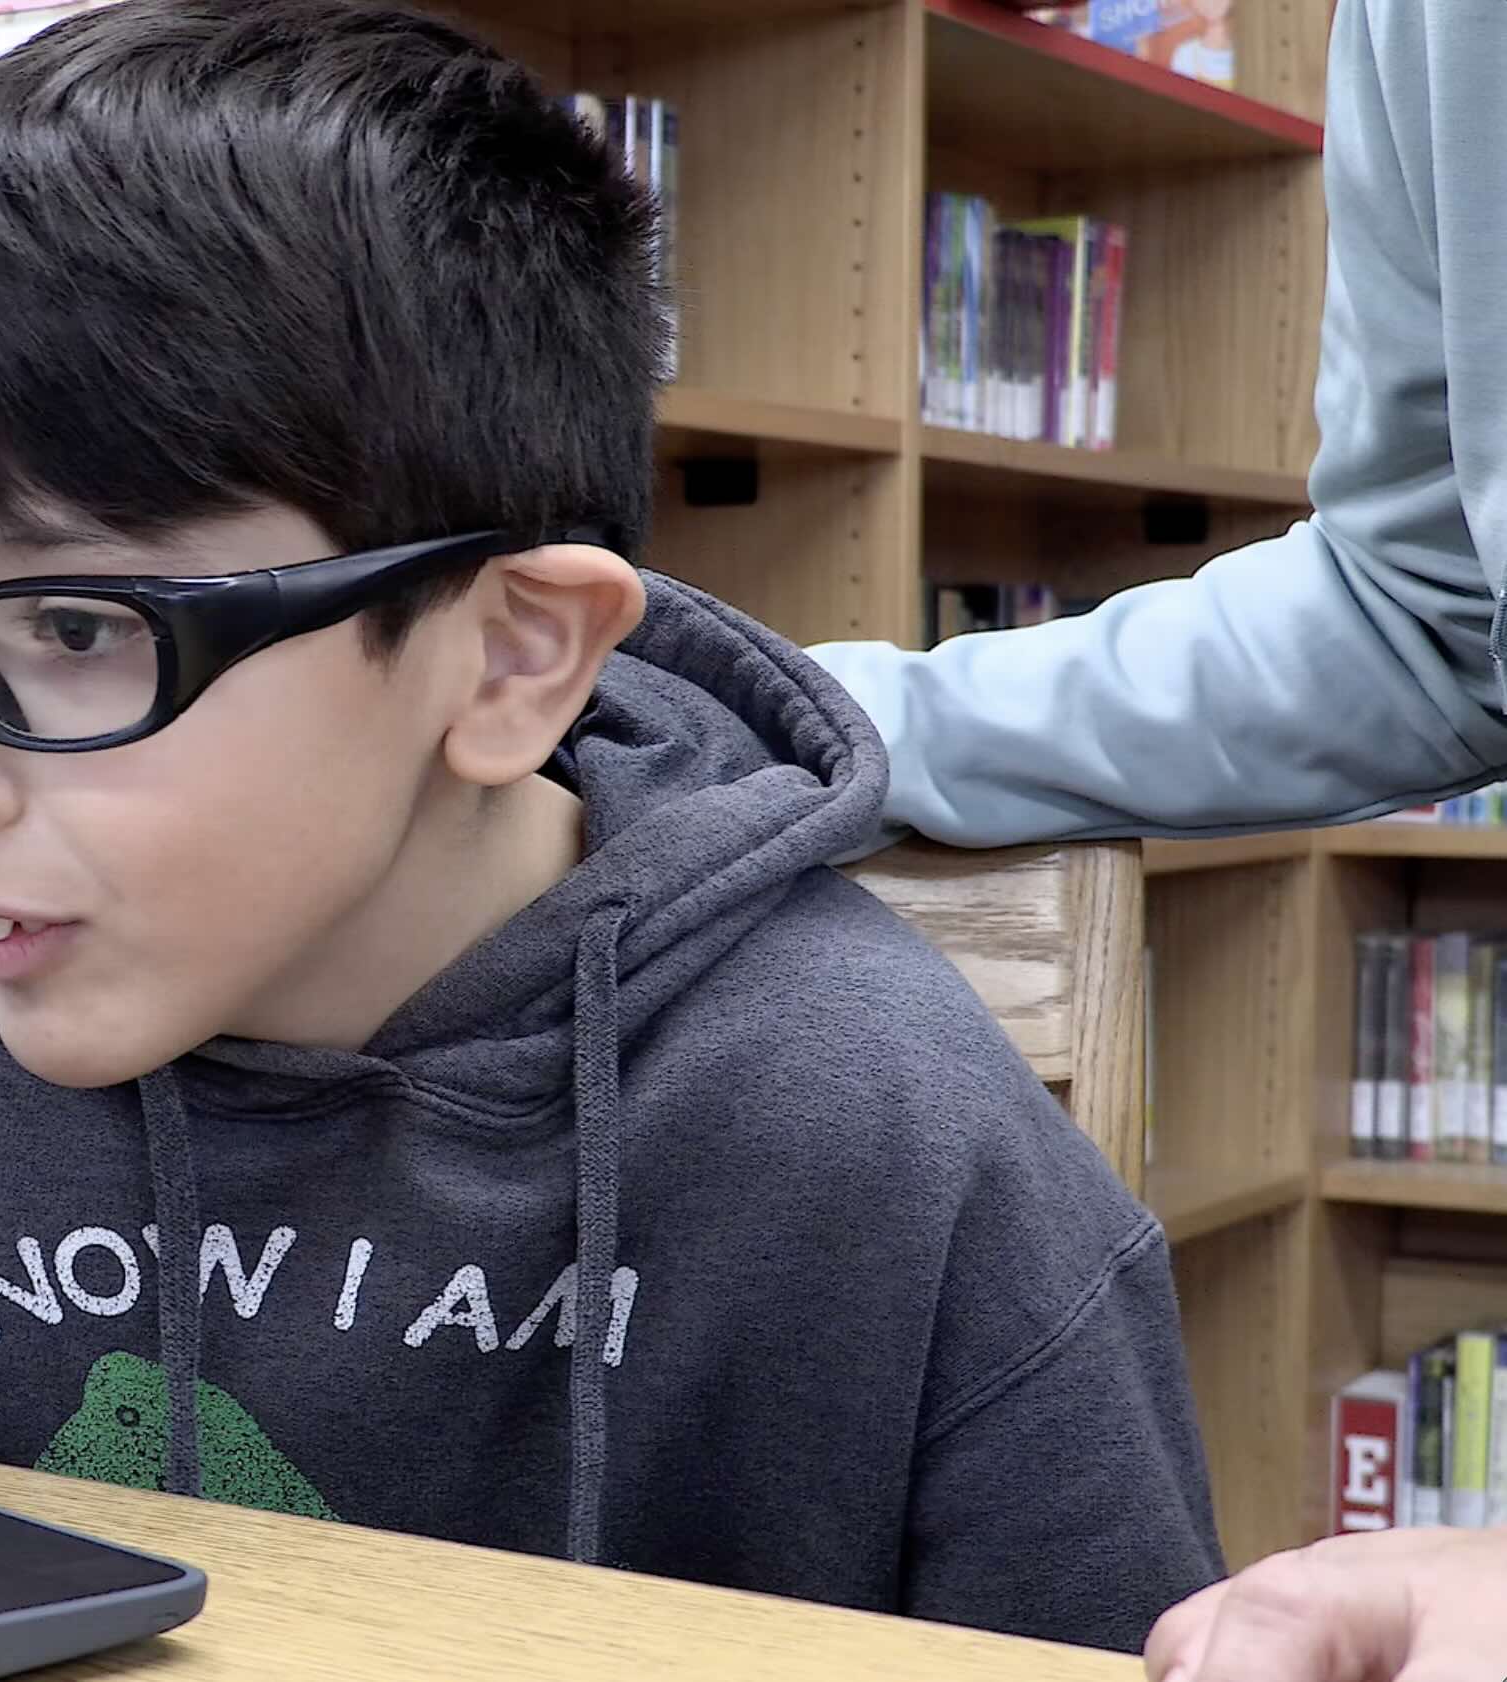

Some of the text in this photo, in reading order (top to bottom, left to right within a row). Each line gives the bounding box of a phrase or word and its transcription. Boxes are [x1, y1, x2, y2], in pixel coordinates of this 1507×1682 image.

[333, 1237, 374, 1331] I
[401, 1263, 640, 1368] AM
[1341, 1434, 1389, 1504] E
